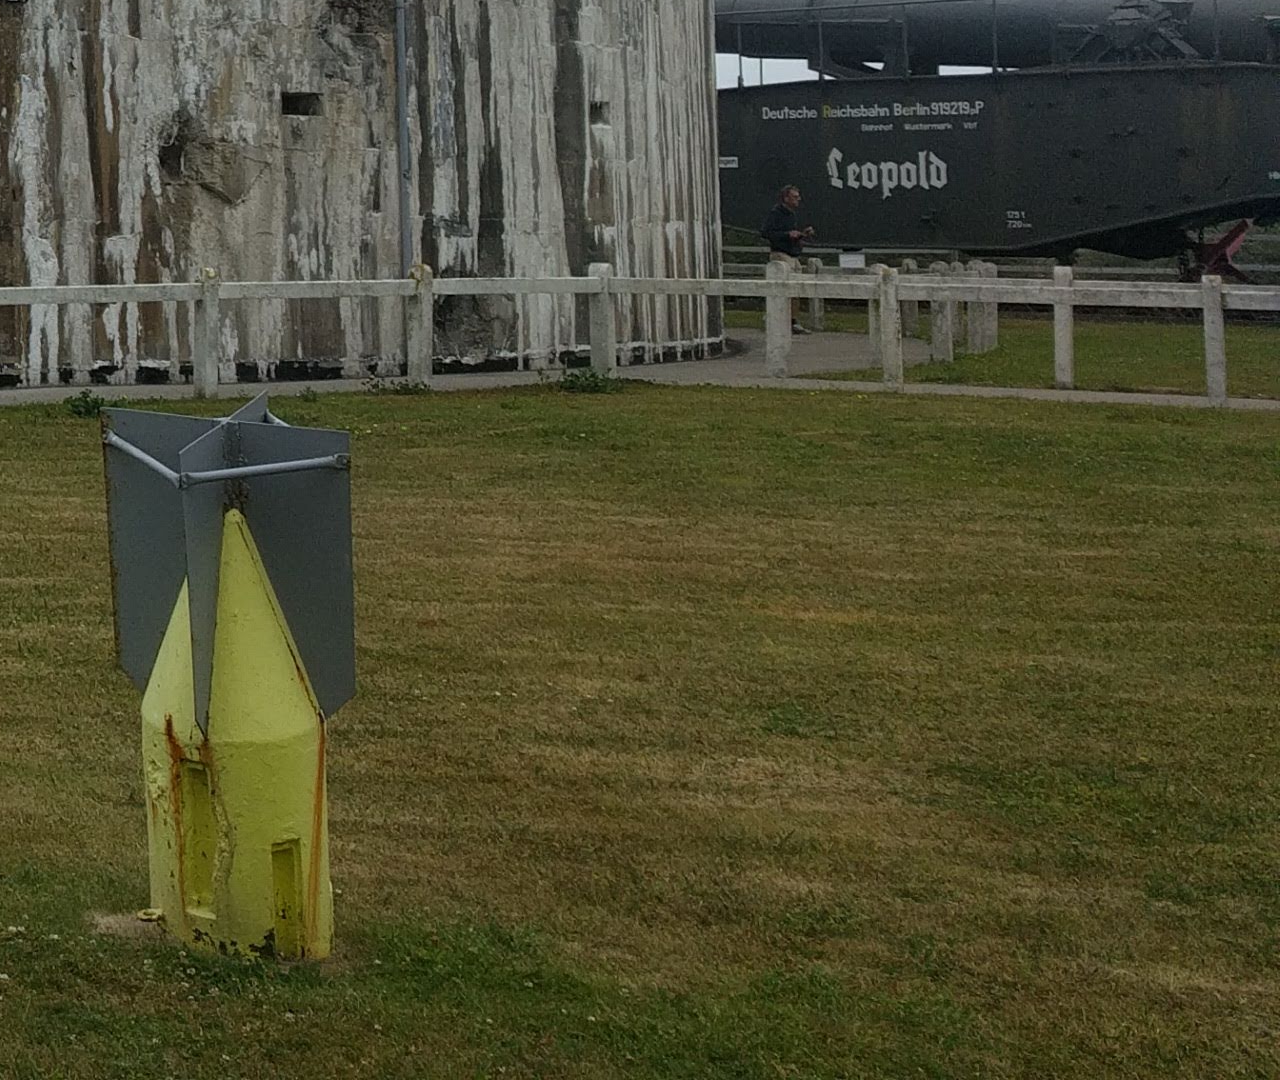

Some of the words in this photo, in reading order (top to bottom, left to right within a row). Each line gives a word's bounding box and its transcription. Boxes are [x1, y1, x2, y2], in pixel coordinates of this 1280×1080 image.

[761, 105, 818, 120] Deutsche
[823, 103, 890, 118] Reichsbahn
[893, 102, 930, 117] Berlin
[826, 146, 948, 200] Leopold
